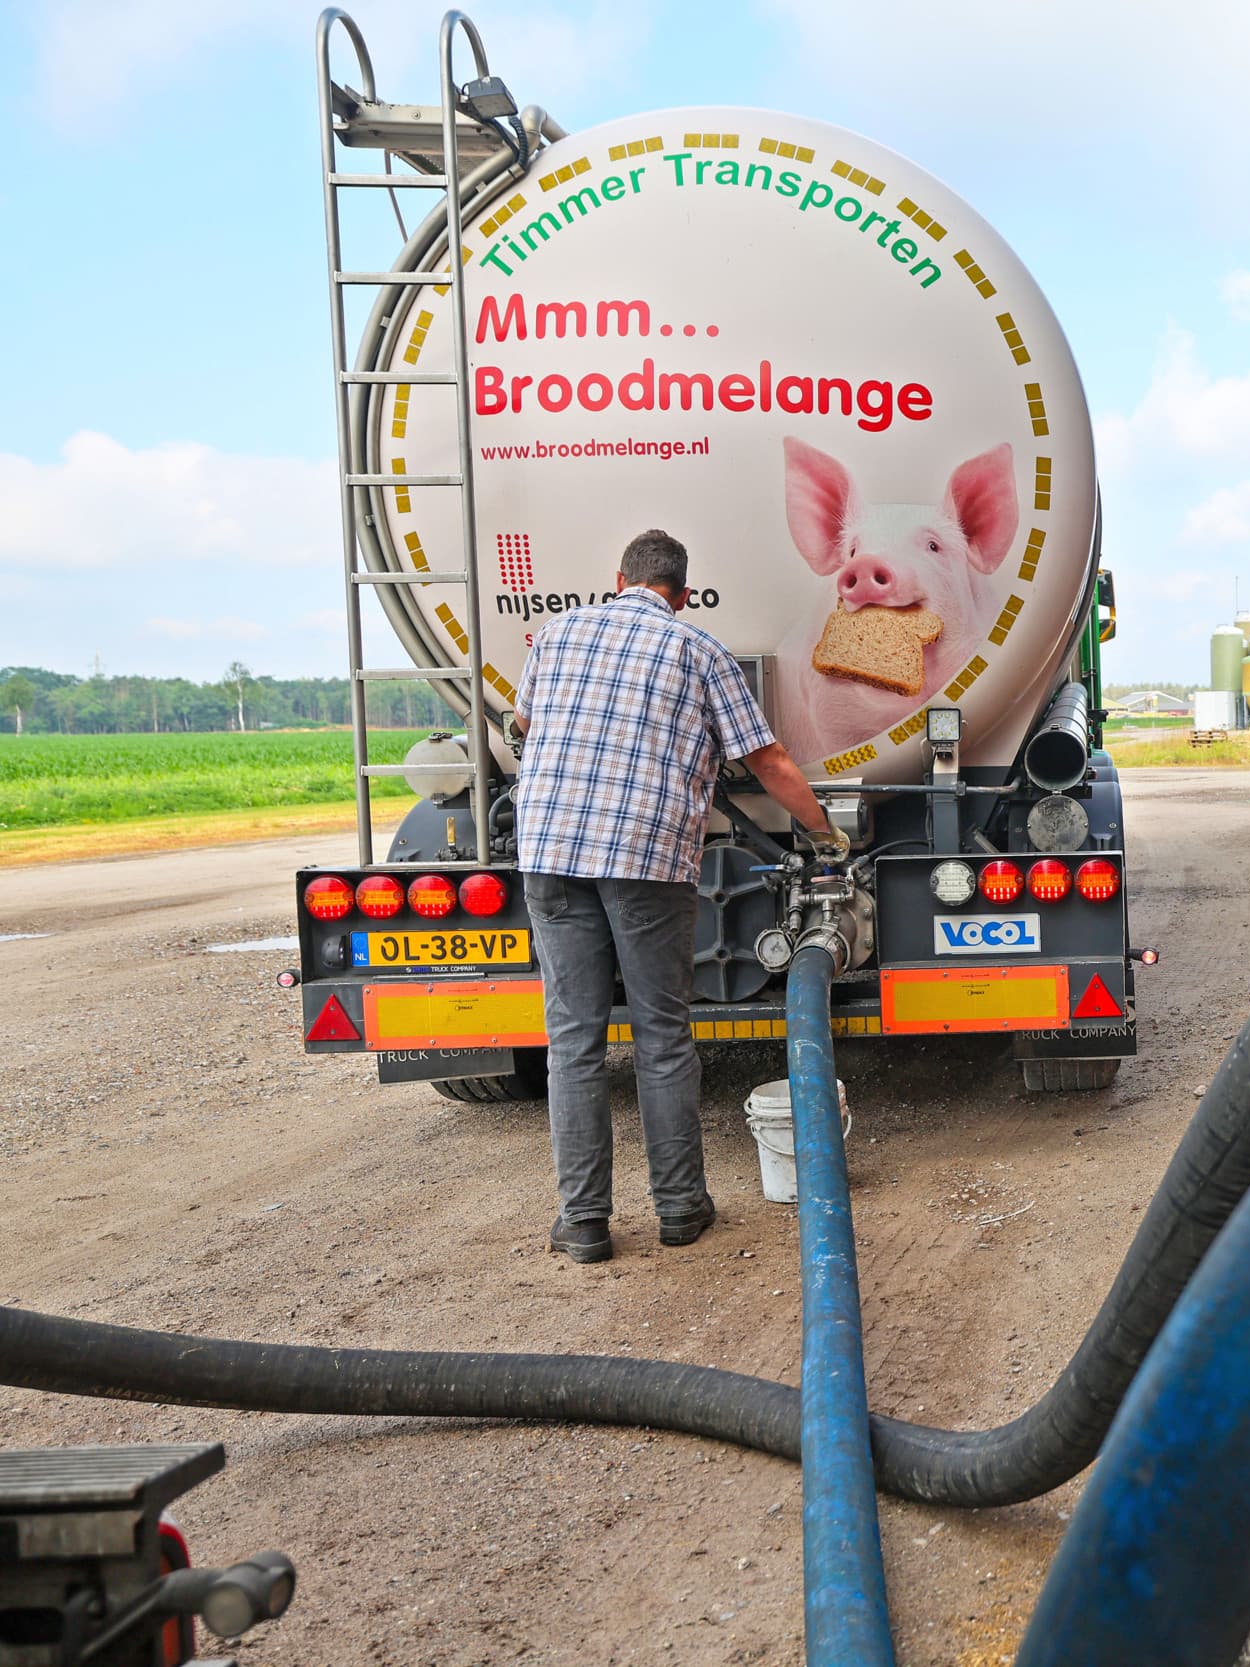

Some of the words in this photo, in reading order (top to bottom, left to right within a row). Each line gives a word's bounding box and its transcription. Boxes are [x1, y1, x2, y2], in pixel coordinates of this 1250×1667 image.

[479, 165, 646, 278] Timmer
[663, 153, 943, 289] Transporten
[475, 293, 720, 344] Mmm...
[475, 358, 933, 433] Broodmelange
[480, 436, 710, 461] www.broodmelange.nl
[940, 920, 1035, 947] VOCOL
[354, 952, 368, 961] NL
[381, 934, 517, 961] OL-38-VP
[1070, 1025, 1136, 1039] COMPANY
[379, 1050, 429, 1064] TRUCK
